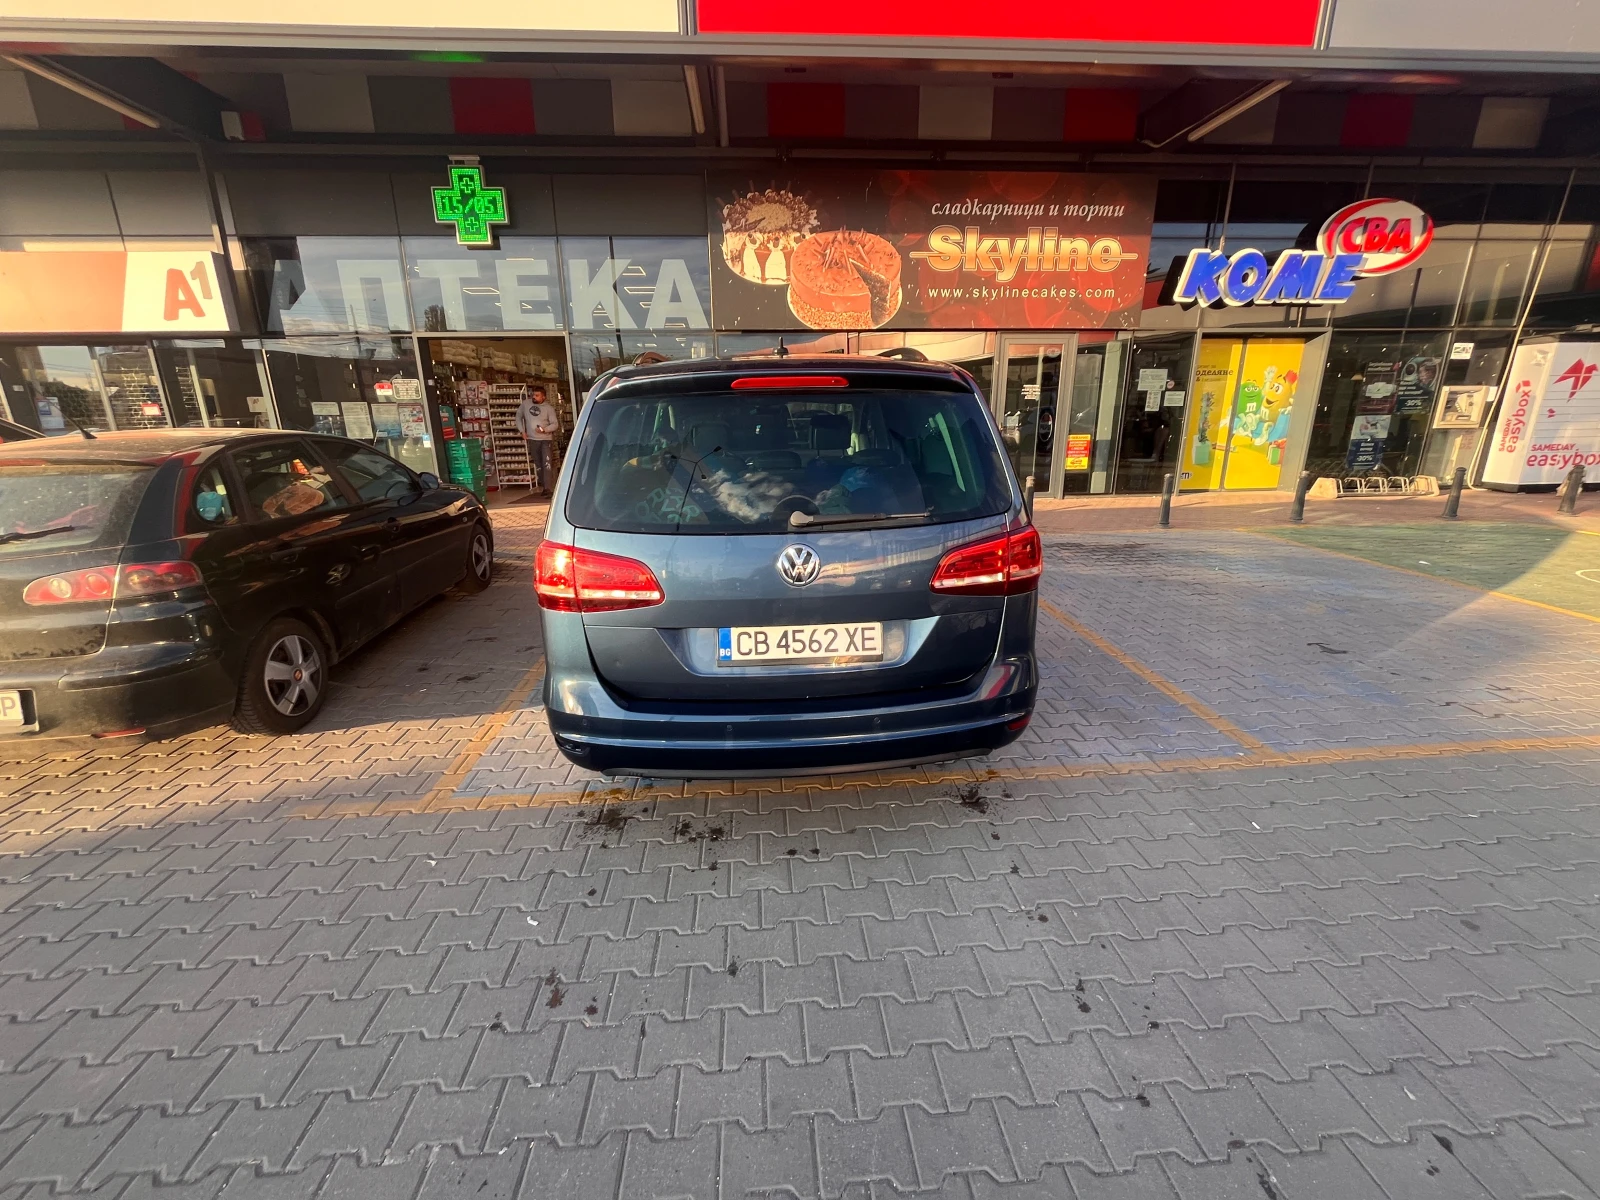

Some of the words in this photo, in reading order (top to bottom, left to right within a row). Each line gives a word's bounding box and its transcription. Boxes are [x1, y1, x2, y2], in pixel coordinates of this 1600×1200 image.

[441, 196, 495, 214] 15/05
[931, 199, 1044, 218] сладкарници
[1049, 206, 1060, 217] и
[1063, 204, 1125, 218] торти
[927, 224, 1123, 283] Skyline
[163, 260, 213, 321] A1
[266, 259, 710, 331] АПТЕКА
[928, 286, 1116, 301] www.skylinecakes.com
[1506, 389, 1532, 453] easybox
[1499, 418, 1512, 452] SAMEDAY
[1530, 443, 1576, 452] SAMEDAY
[720, 648, 731, 656] BG
[737, 631, 770, 656] CB
[776, 629, 839, 654] 4562
[844, 627, 877, 652] XE
[0, 697, 16, 717] P
